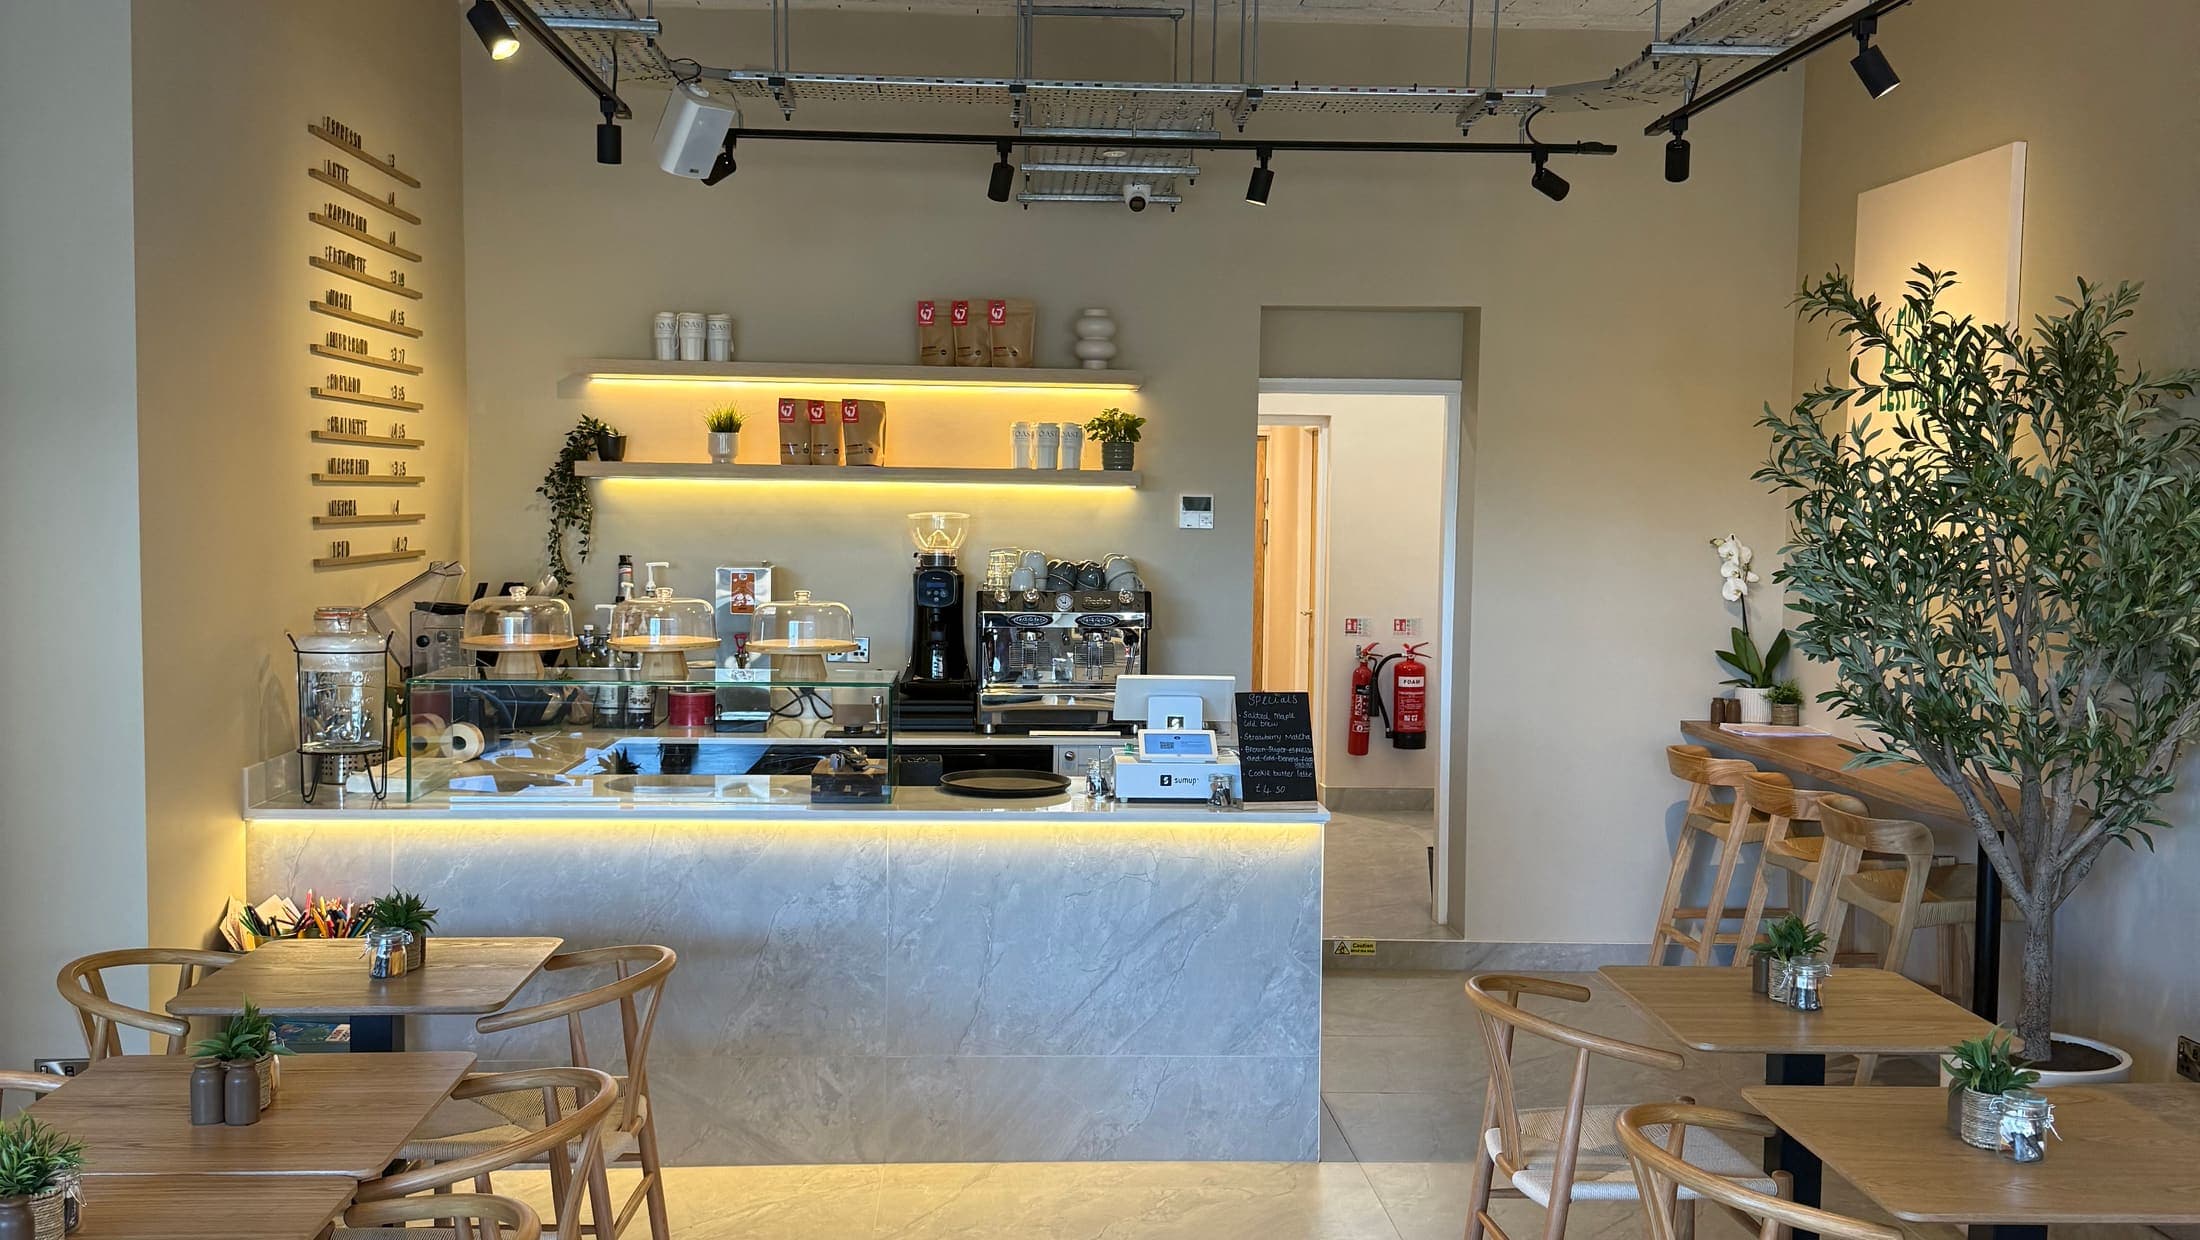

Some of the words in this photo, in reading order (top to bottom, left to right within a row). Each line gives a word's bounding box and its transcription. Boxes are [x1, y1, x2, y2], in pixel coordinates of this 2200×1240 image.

[326, 116, 361, 149] ESPRESSO
[327, 159, 349, 184] LATTE
[329, 288, 352, 311] MOCHA
[330, 373, 360, 393] CORTADO
[1244, 732, 1281, 743] Strawberry
